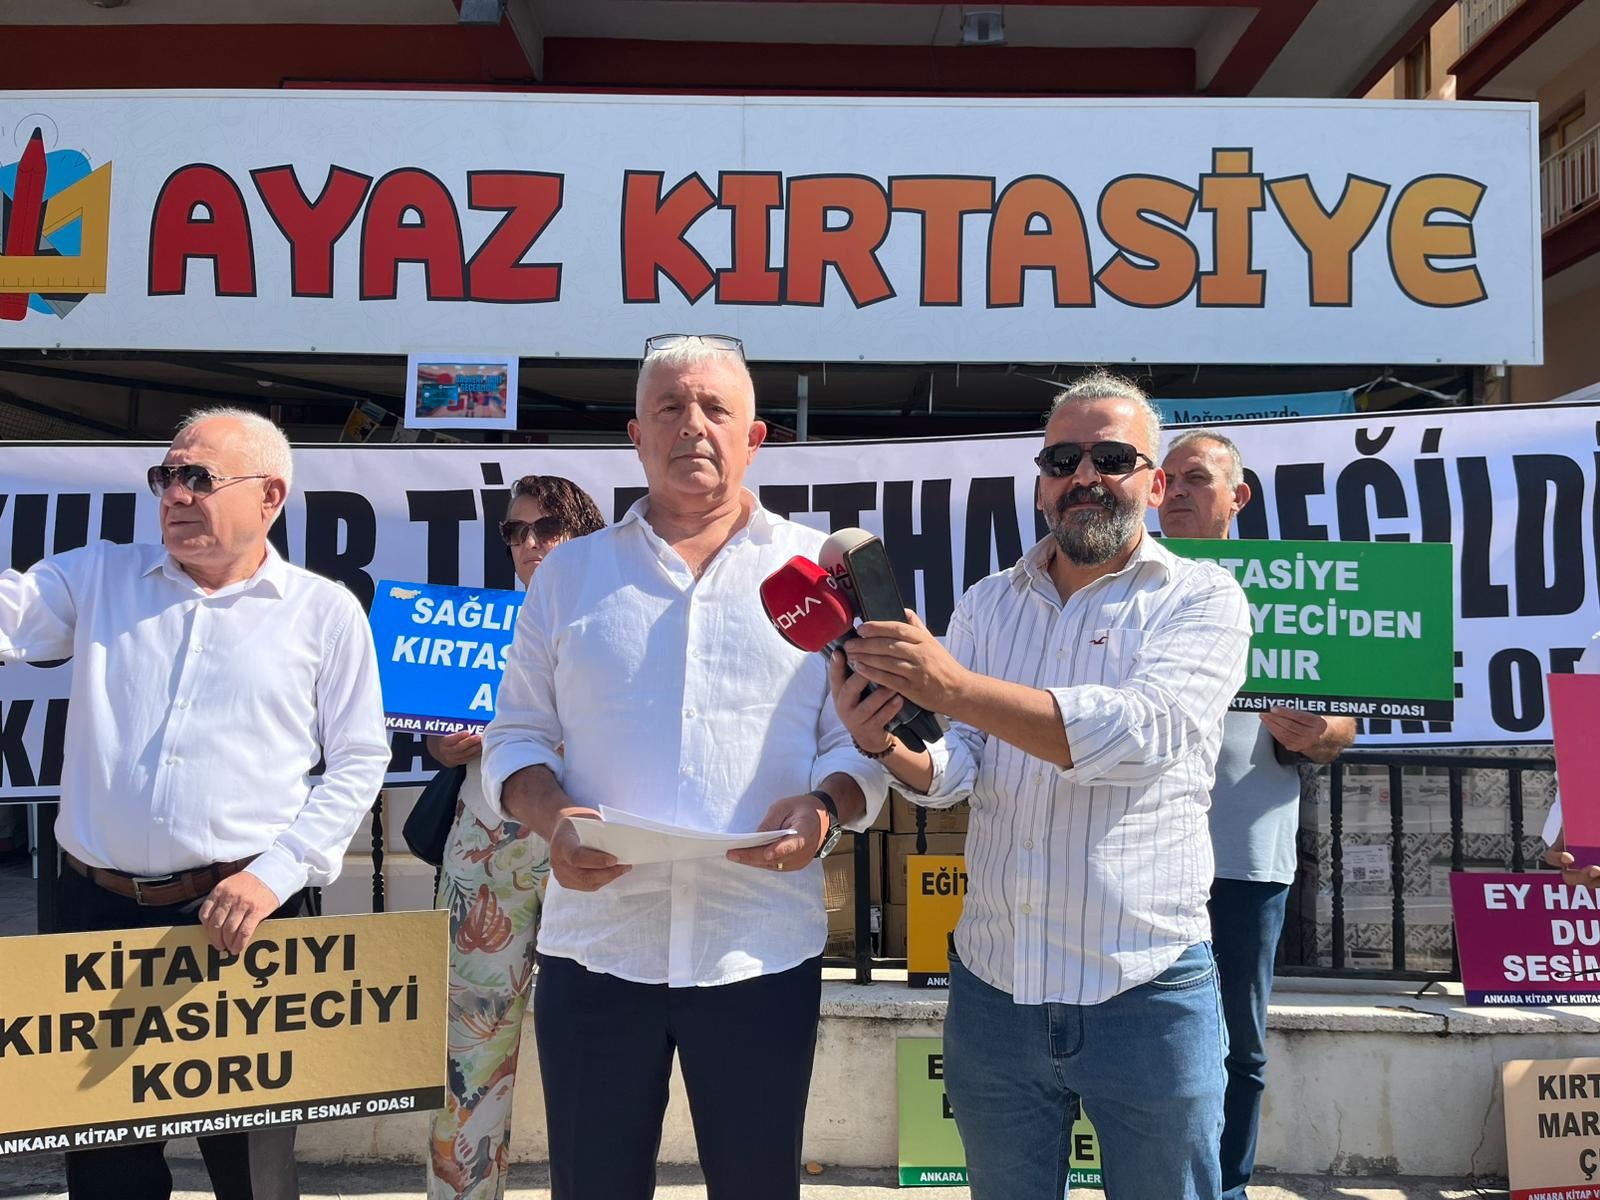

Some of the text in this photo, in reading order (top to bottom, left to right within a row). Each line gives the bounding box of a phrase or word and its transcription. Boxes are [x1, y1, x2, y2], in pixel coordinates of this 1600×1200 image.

[147, 147, 1488, 308] AYAZ KIRTASİYE
[1197, 552, 1360, 592] TASİYE
[411, 595, 521, 631] SAĞLI
[777, 597, 822, 630] DHA
[385, 717, 421, 730] KARA
[424, 719, 464, 733] KİTAP
[1330, 701, 1376, 714] ESNAF
[1382, 704, 1425, 717] ODASI
[1483, 883, 1600, 910] EY HA
[64, 934, 356, 993] KİTAPÇIYI
[926, 977, 950, 986] ANK
[1483, 994, 1523, 1004] ANKARA
[1525, 993, 1553, 1004] KİTAP
[1554, 994, 1569, 1004] VE
[0, 975, 419, 1057] KIRTASİYECİYİ
[132, 1050, 293, 1103] KORU
[74, 1126, 129, 1146] KİTAP
[134, 1124, 157, 1139] VE
[161, 1107, 303, 1137] KIRTASİYECİLER
[307, 1100, 362, 1119] ESNAF
[366, 1095, 415, 1111] ODASI
[919, 1171, 963, 1182] ANKARA
